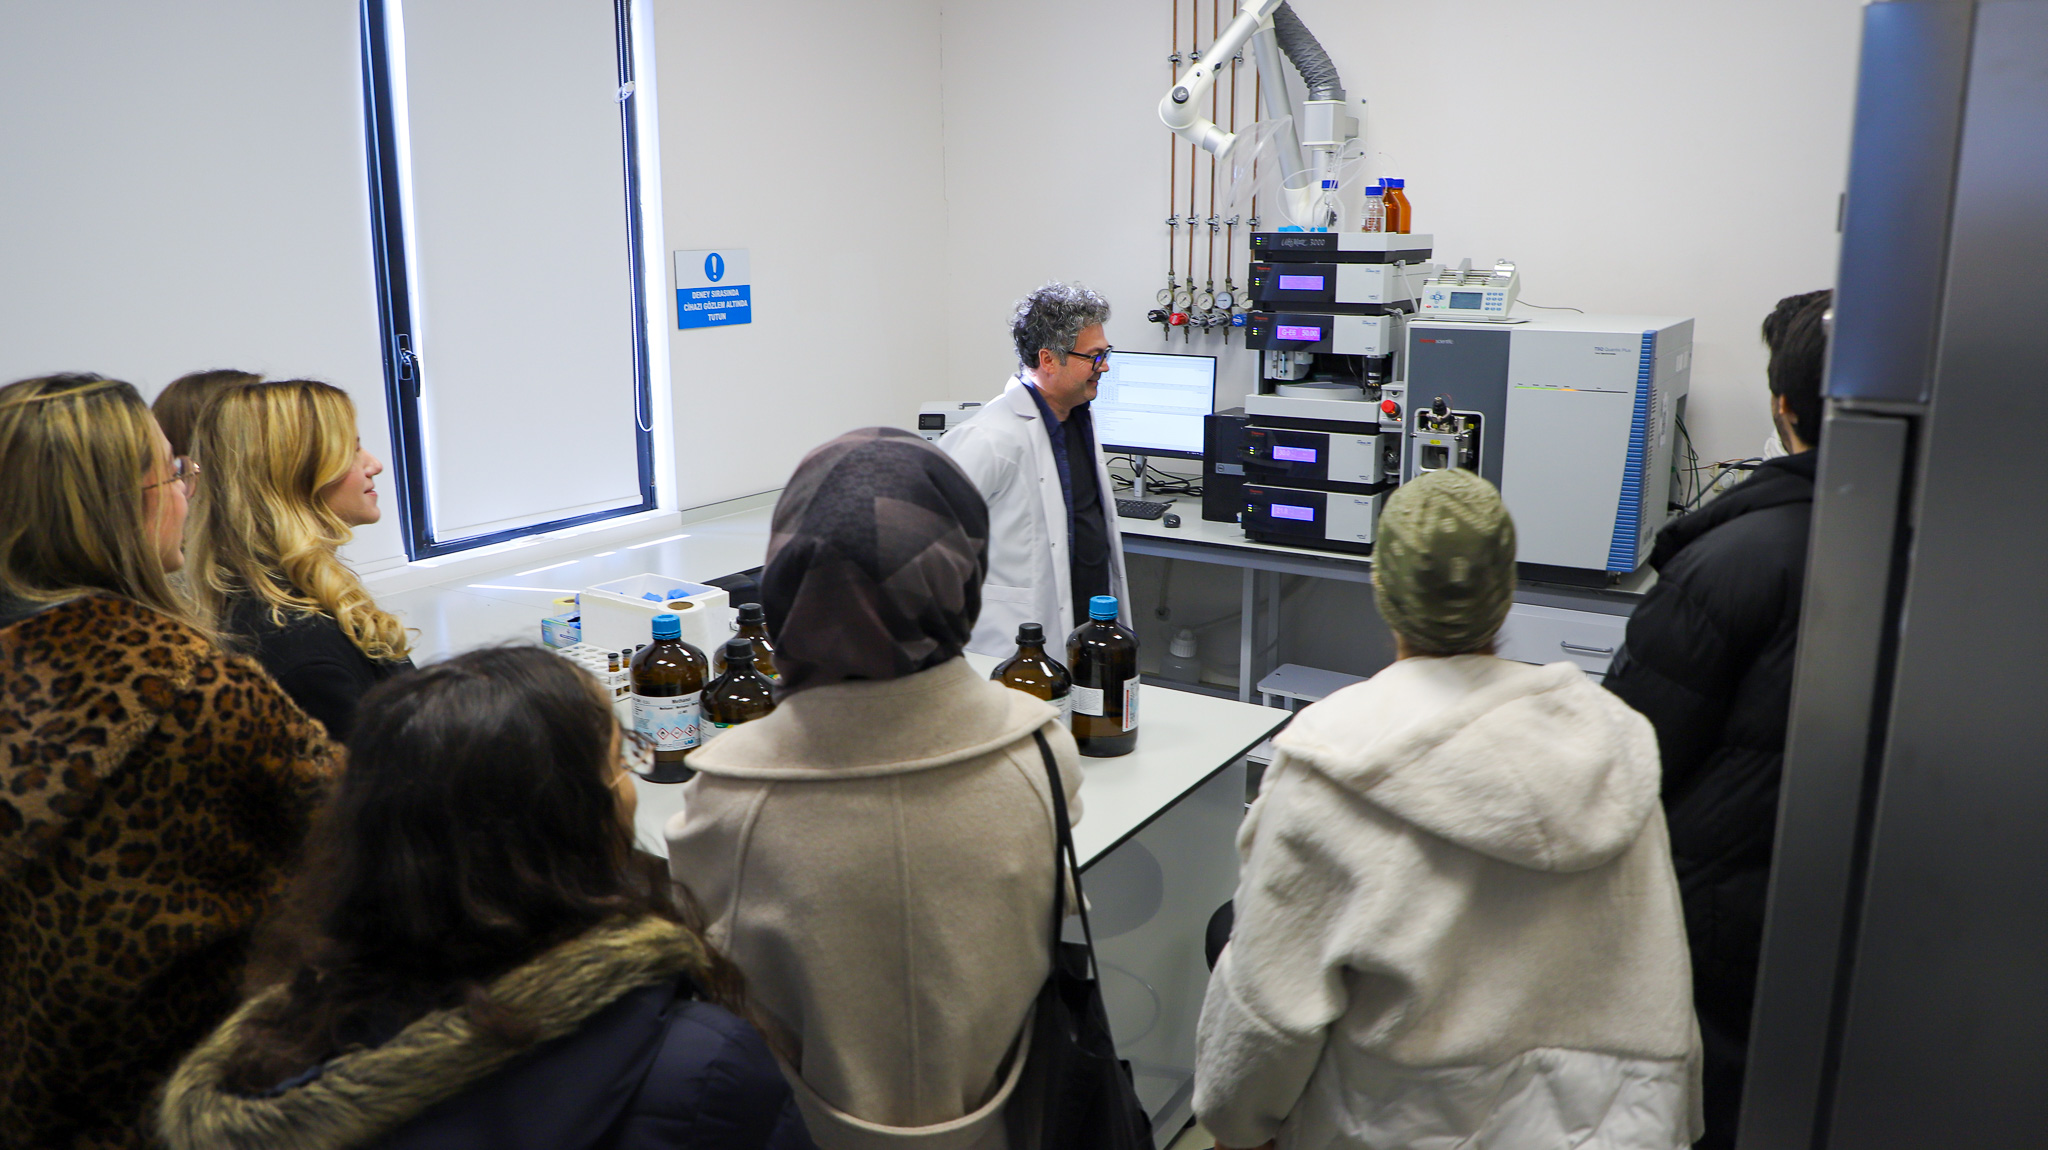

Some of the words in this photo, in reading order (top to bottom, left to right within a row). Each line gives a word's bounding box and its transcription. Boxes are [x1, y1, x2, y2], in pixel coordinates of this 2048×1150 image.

[1310, 238, 1326, 246] 3000
[692, 291, 710, 299] DENEY
[711, 289, 739, 298] SIRASINDA
[684, 302, 702, 311] CİHAZI
[703, 301, 725, 310] GÖZLEM
[726, 300, 748, 308] ALTINDA
[707, 313, 726, 321] TUTUN
